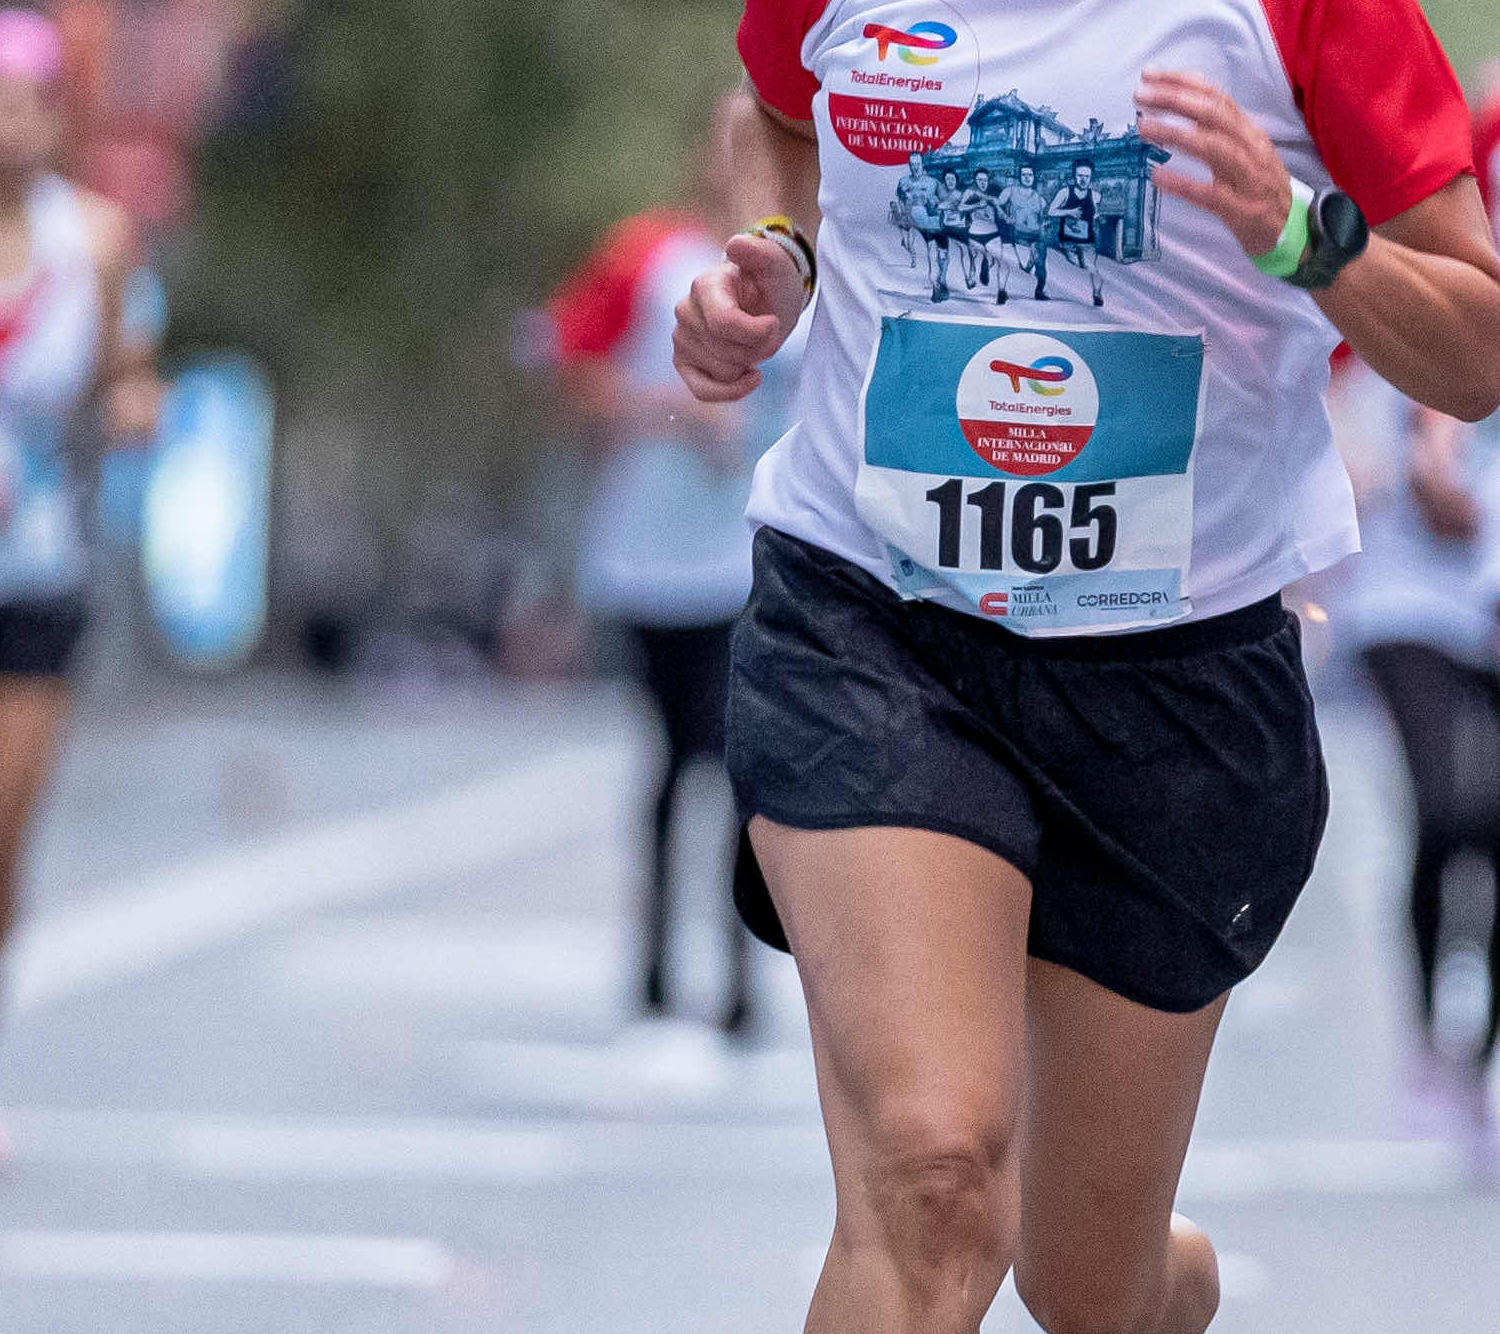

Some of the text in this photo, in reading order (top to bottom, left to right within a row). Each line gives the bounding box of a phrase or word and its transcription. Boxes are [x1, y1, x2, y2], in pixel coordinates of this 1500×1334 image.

[850, 69, 943, 92] TotalEnergies
[864, 103, 908, 120] MILLA
[847, 133, 924, 153] DE MADRID
[988, 400, 1072, 417] TotalEnergies
[1008, 427, 1047, 440] MILLA
[991, 449, 1062, 465] DE MADRID
[925, 478, 1118, 575] 1165
[1012, 592, 1052, 604] MILLA
